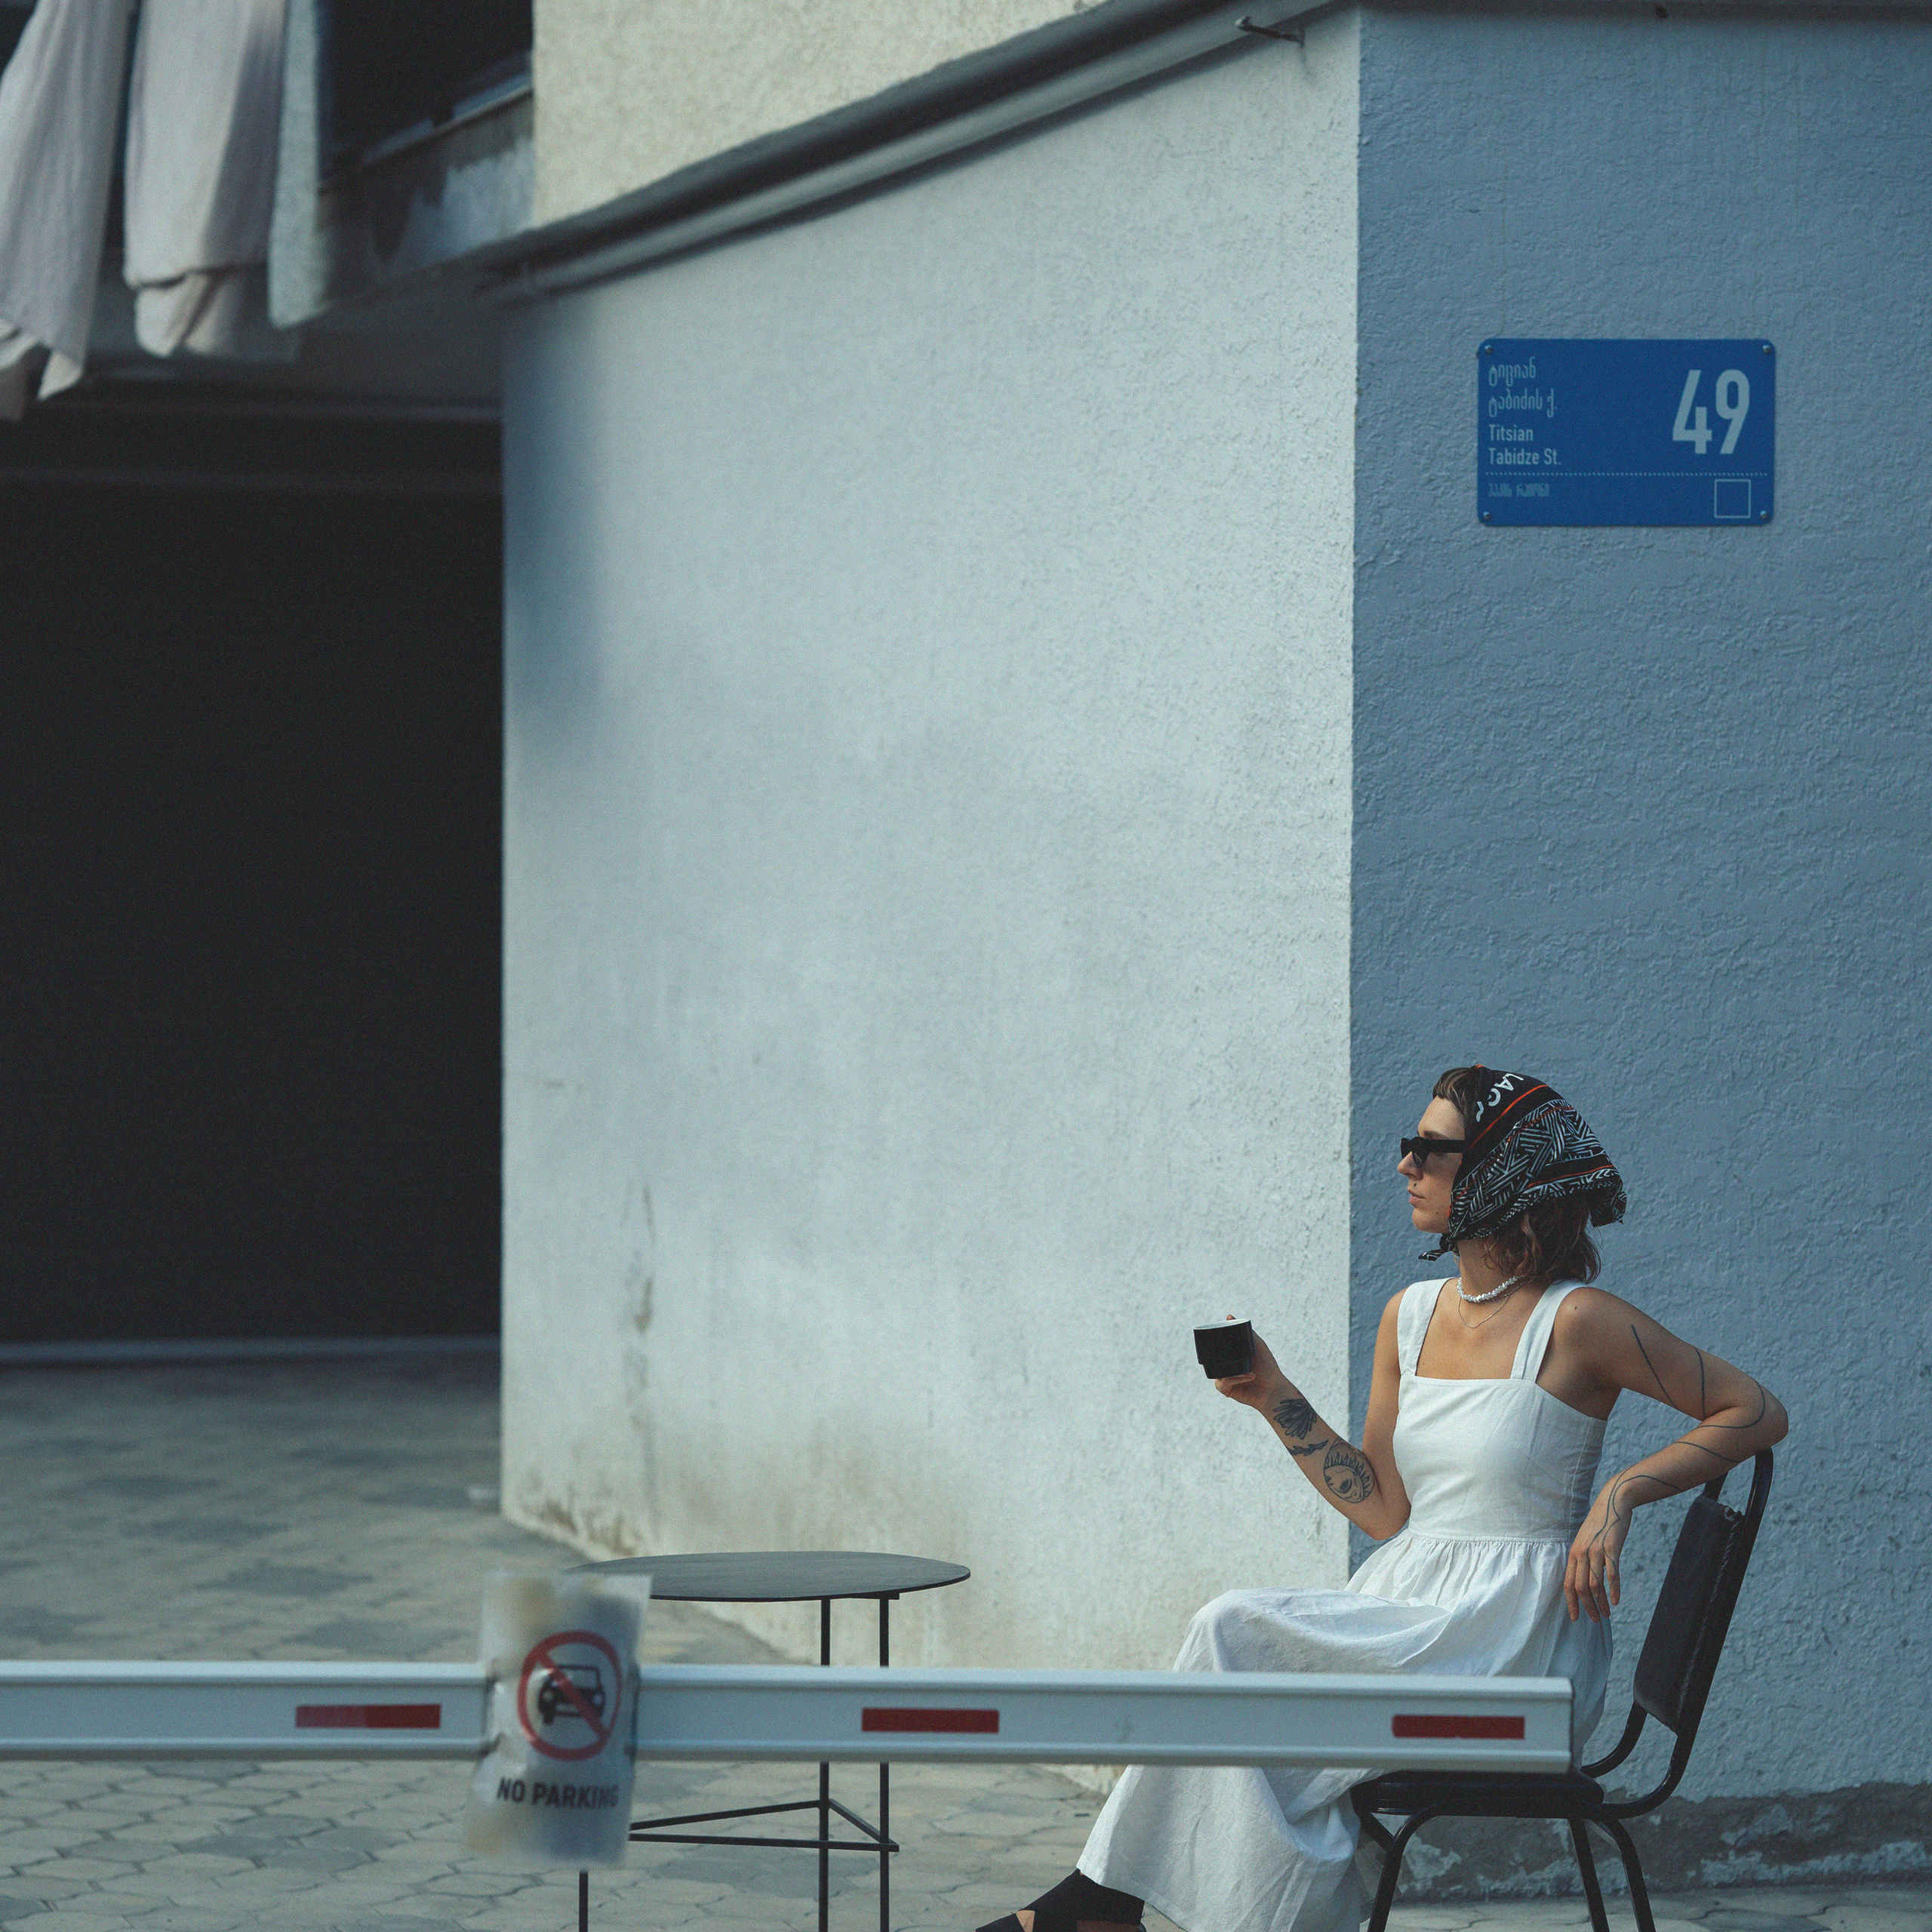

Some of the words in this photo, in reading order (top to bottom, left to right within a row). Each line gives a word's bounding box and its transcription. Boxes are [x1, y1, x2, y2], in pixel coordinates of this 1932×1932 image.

[1489, 356, 1536, 386] ტიციან
[1489, 387, 1543, 417] ტაბიძის
[1672, 369, 1750, 454] 49
[1489, 424, 1534, 441] Titsian
[1488, 448, 1540, 465] Tabidze
[1544, 448, 1561, 465] St.
[497, 1777, 525, 1803] NO
[531, 1782, 619, 1809] PARKING
